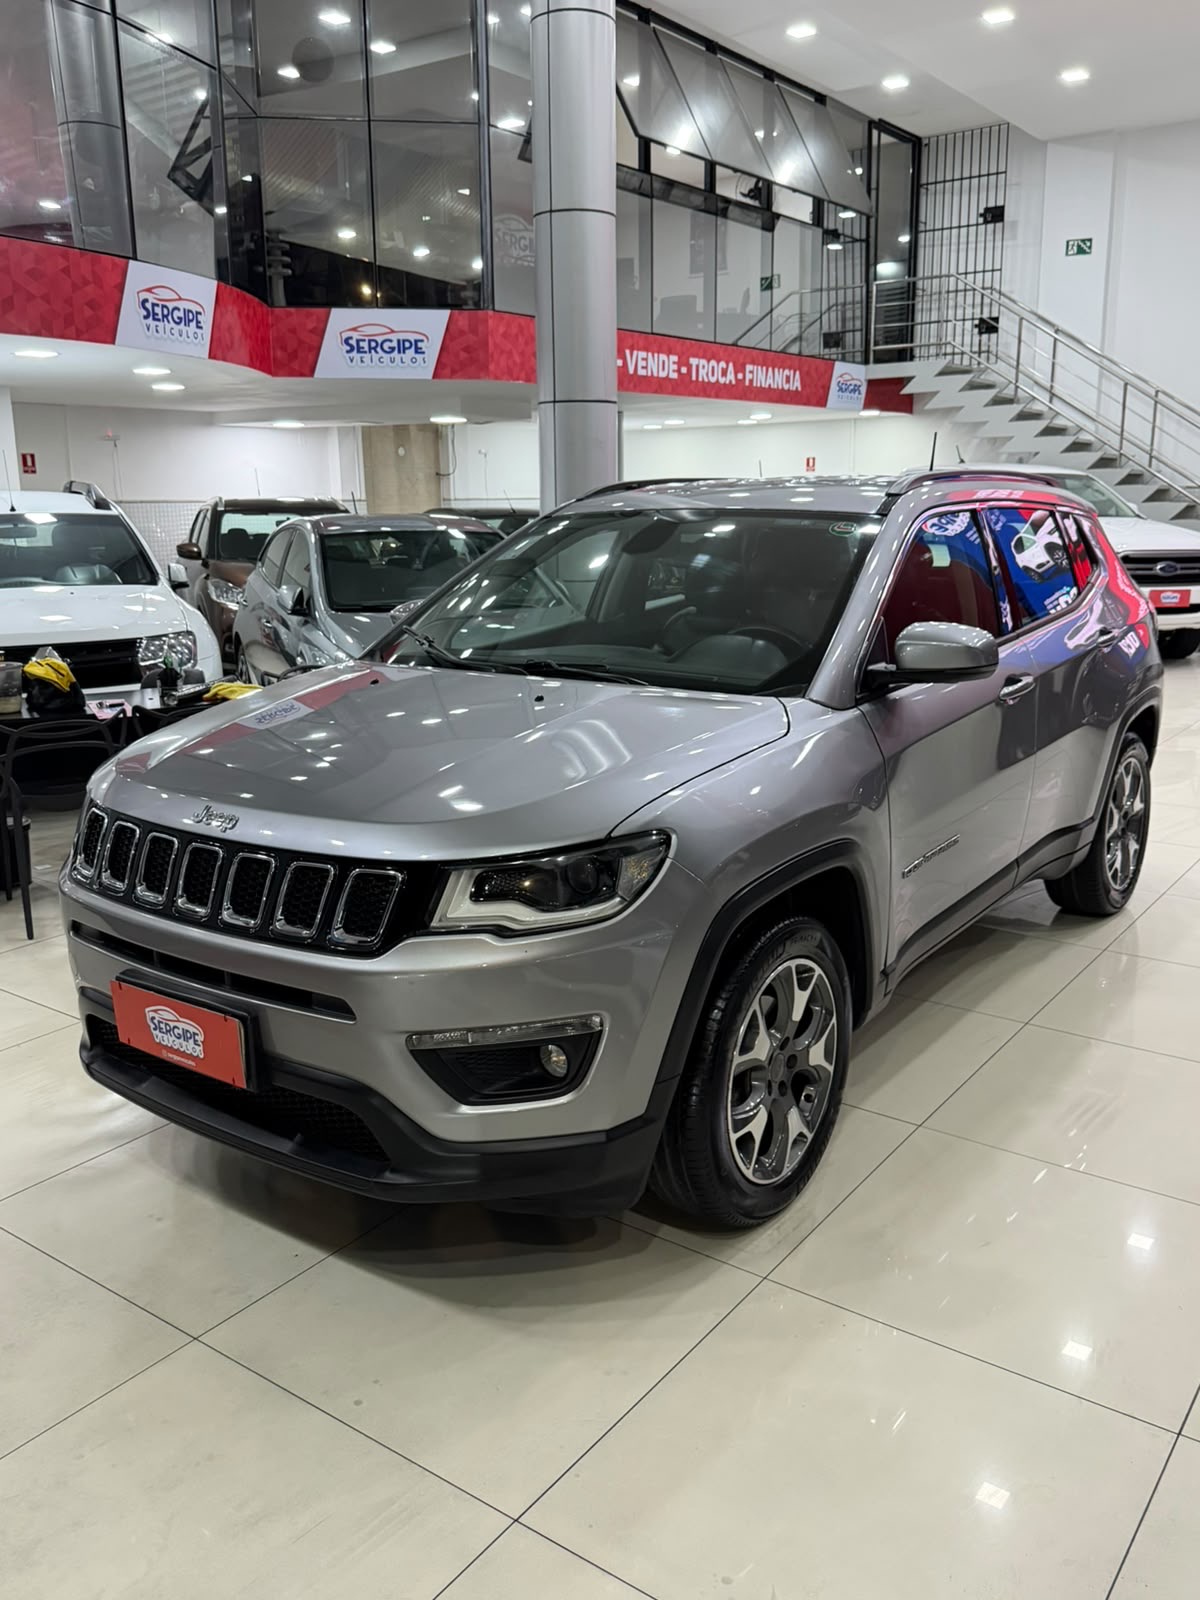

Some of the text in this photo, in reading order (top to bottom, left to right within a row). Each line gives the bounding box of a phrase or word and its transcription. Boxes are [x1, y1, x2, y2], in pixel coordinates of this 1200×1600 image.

[140, 297, 204, 331] SERGIPE
[145, 322, 205, 342] VEÍCULOS
[343, 335, 426, 355] SERGIPE
[348, 354, 427, 365] VEÍCULOS
[624, 348, 679, 380] VENDE
[688, 356, 736, 385] TROCA
[744, 363, 802, 392] FINANCIA
[192, 803, 240, 834] Jeep
[149, 1015, 202, 1048] SERGIPE
